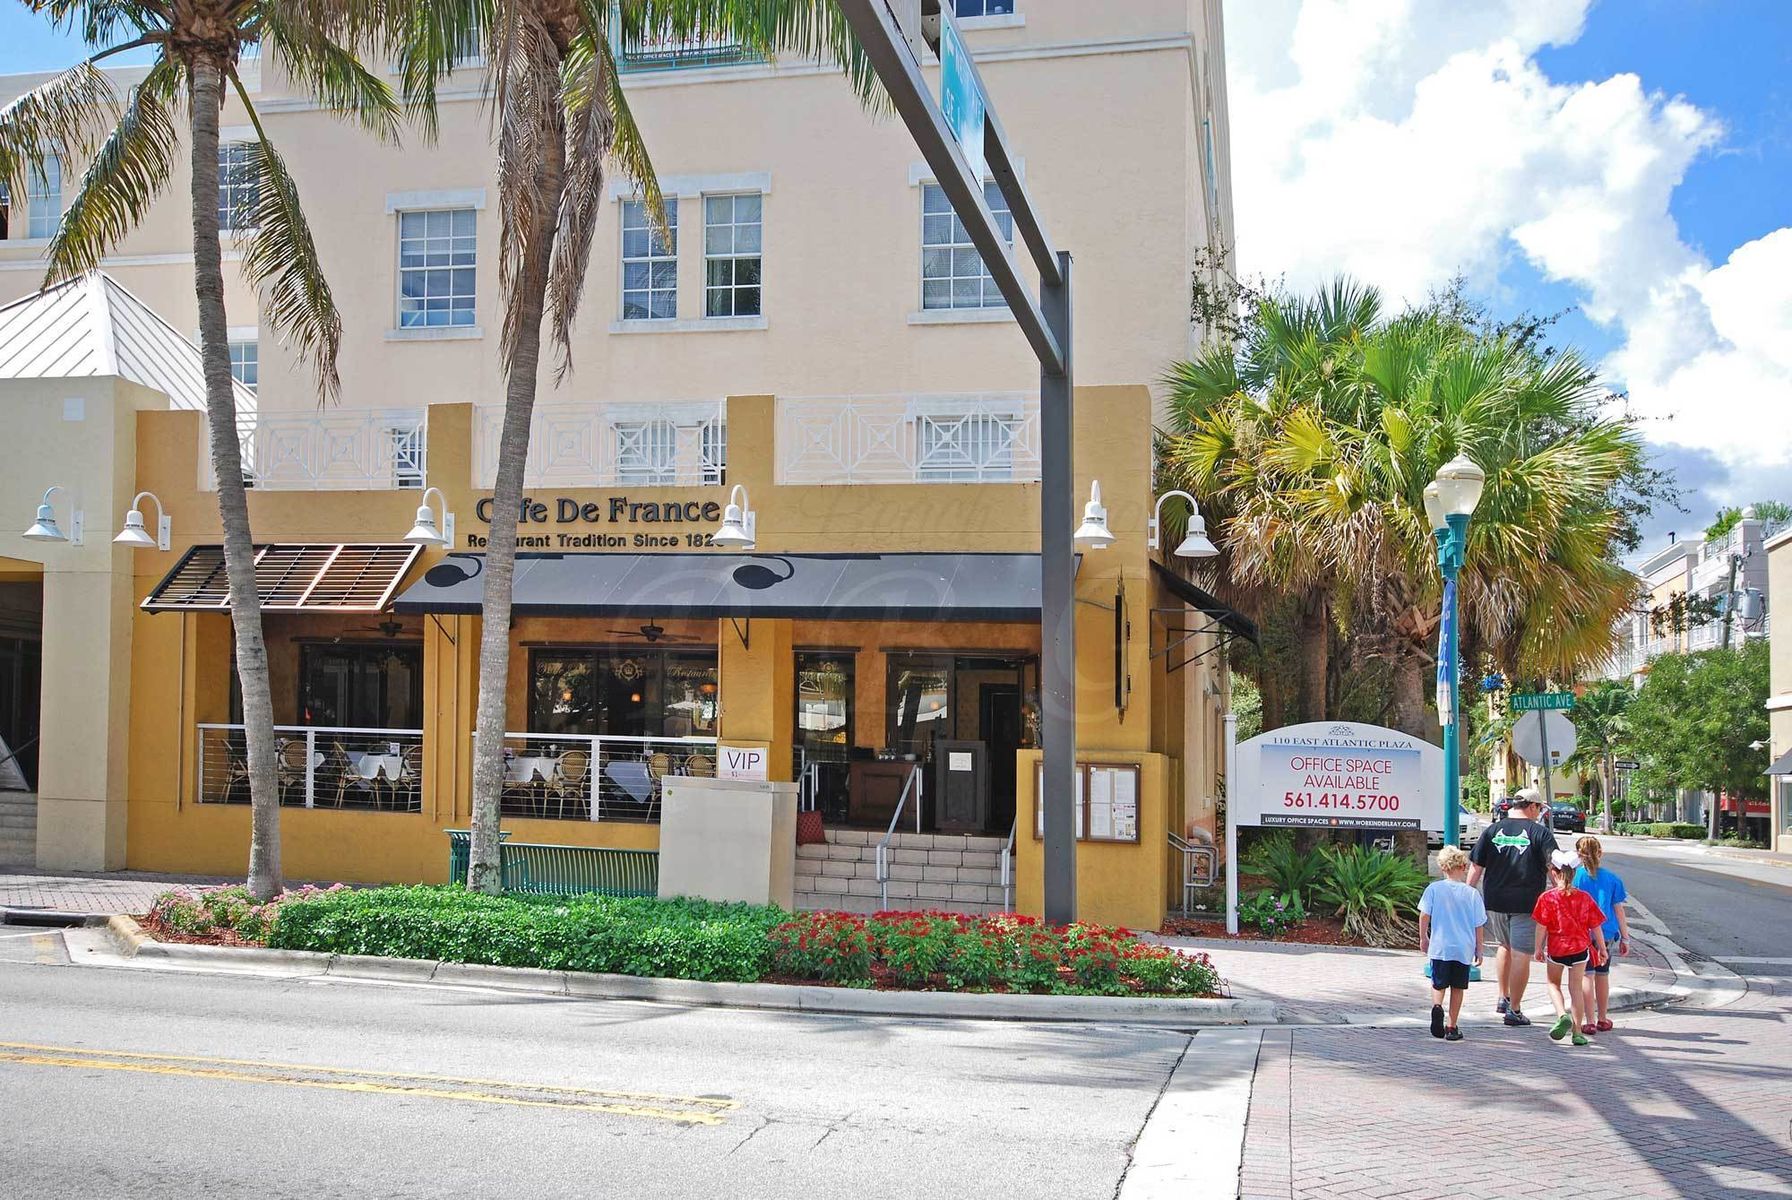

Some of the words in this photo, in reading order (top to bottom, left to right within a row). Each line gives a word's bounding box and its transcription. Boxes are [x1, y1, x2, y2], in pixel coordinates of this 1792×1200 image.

[476, 497, 548, 523] Cfe
[556, 498, 600, 523] De
[608, 497, 721, 523] France
[467, 534, 551, 547] Rerant
[557, 533, 627, 547] Tradition
[633, 533, 679, 548] Since
[686, 534, 725, 548] 182
[1513, 695, 1551, 709] ATLANTIC
[1555, 694, 1572, 707] AVE
[1273, 737, 1290, 745] 110
[1293, 737, 1319, 746] EAST
[1322, 738, 1377, 748] ATLANTIC
[1379, 741, 1413, 749] PLAZA
[727, 751, 760, 770] VIP
[1290, 756, 1342, 772] OFFICE
[1346, 758, 1391, 774] SPACE
[1304, 774, 1380, 791] AVAILABLE
[1284, 791, 1400, 811] 561.414.5700
[1265, 816, 1286, 824] LUXURY
[1287, 817, 1307, 825] OFFICE
[1307, 817, 1329, 826] SPACES
